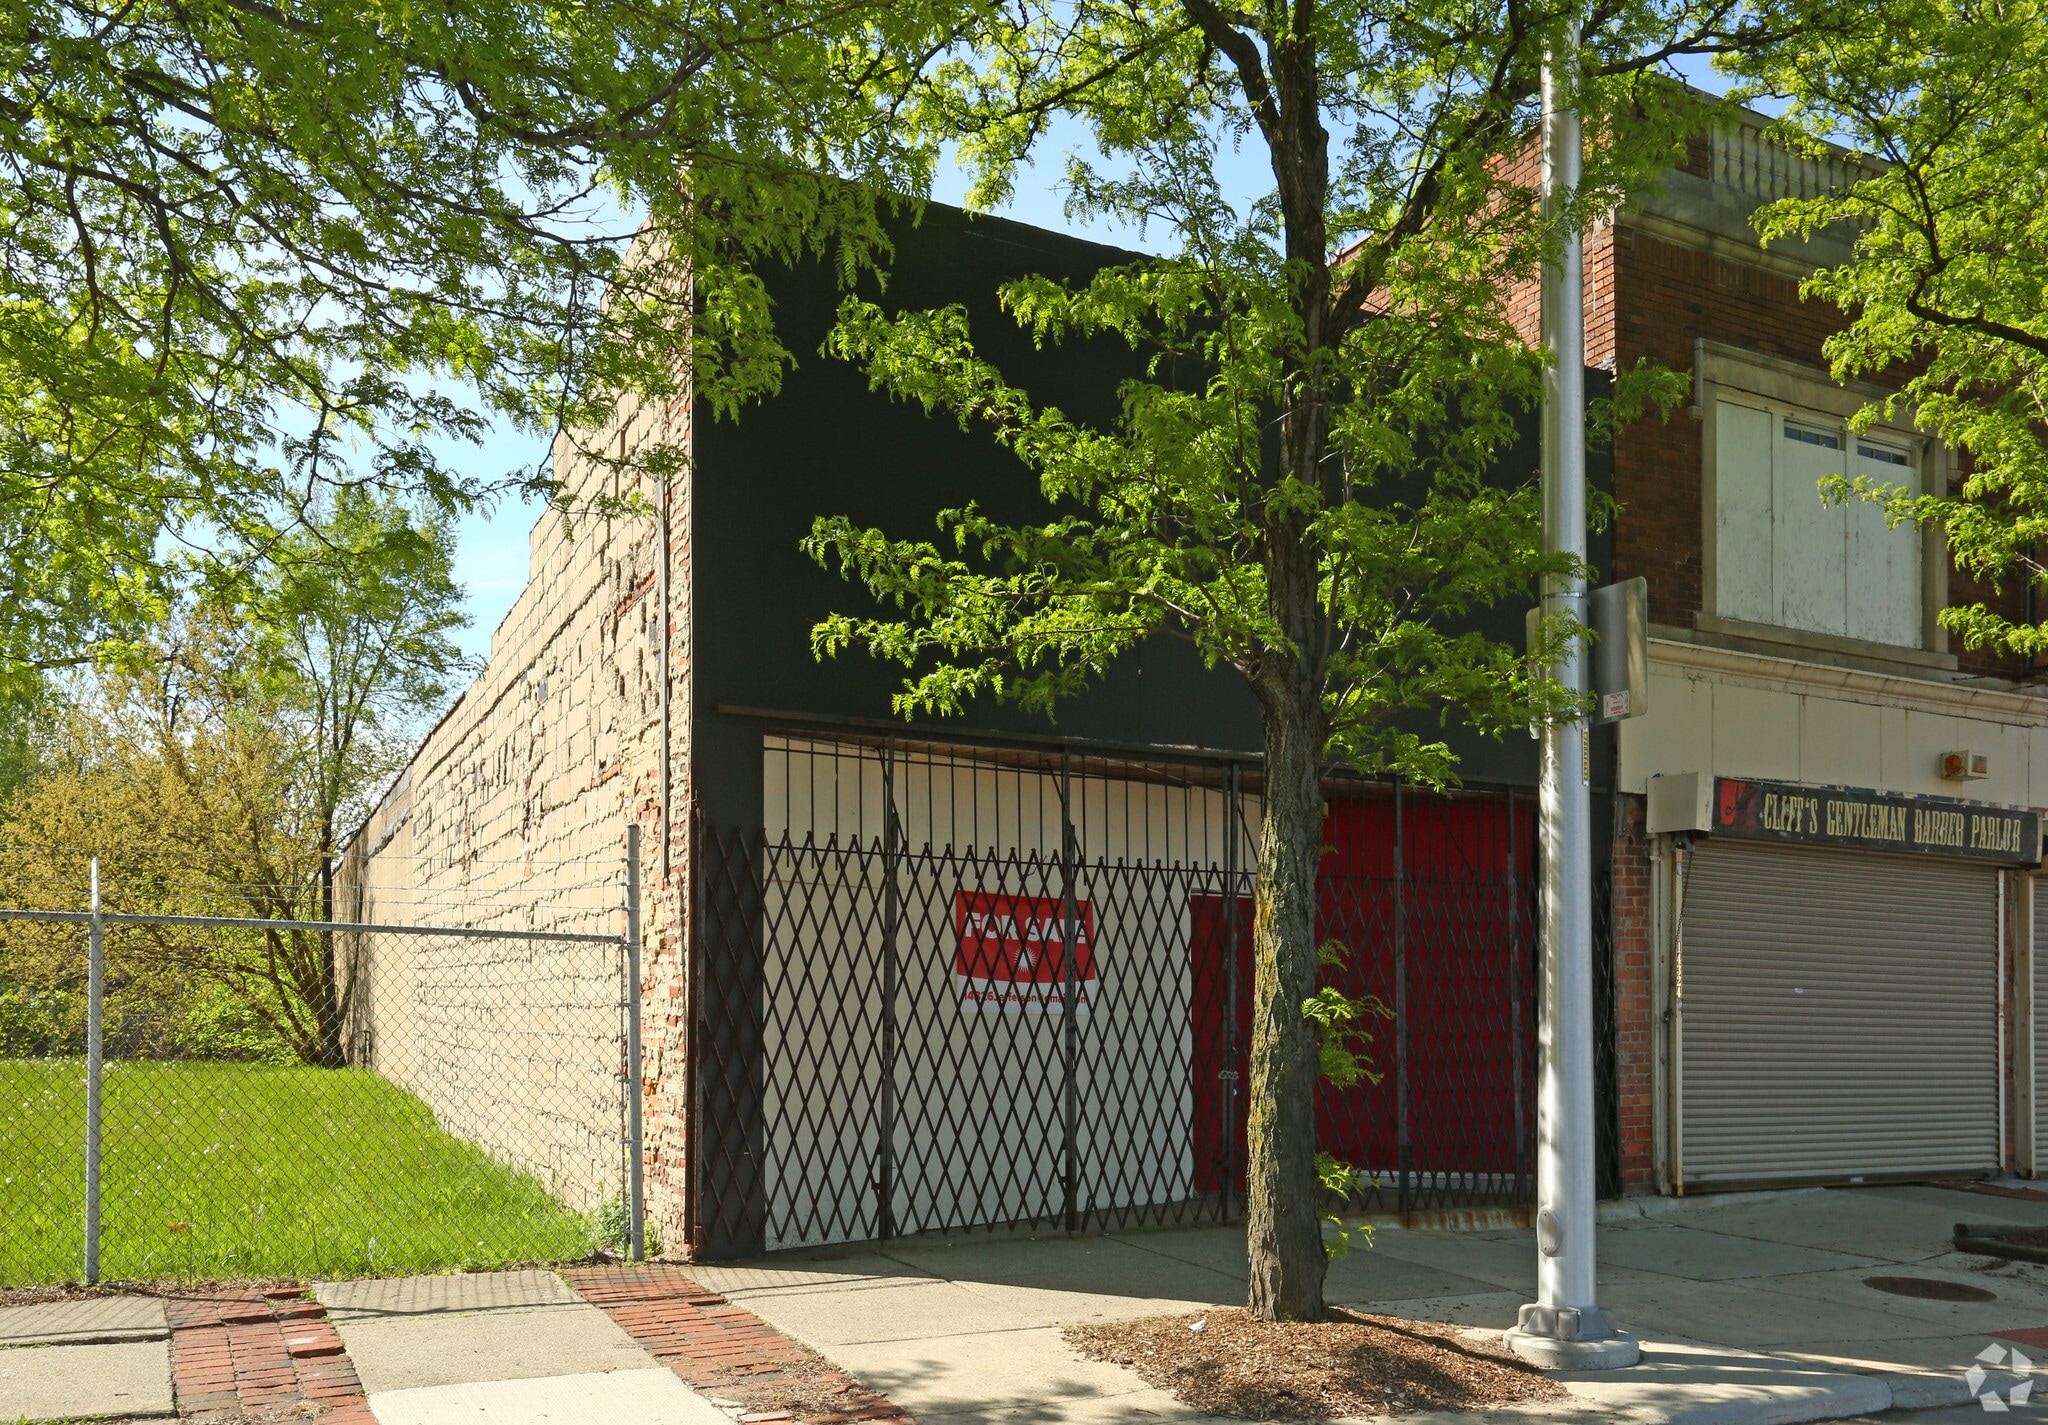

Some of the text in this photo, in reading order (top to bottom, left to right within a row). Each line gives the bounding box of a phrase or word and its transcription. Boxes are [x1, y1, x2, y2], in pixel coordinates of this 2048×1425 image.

[1764, 793, 2022, 853] CLIFF'S GENTLEMAN BARBER PARLOR
[965, 912, 1020, 940] FOR
